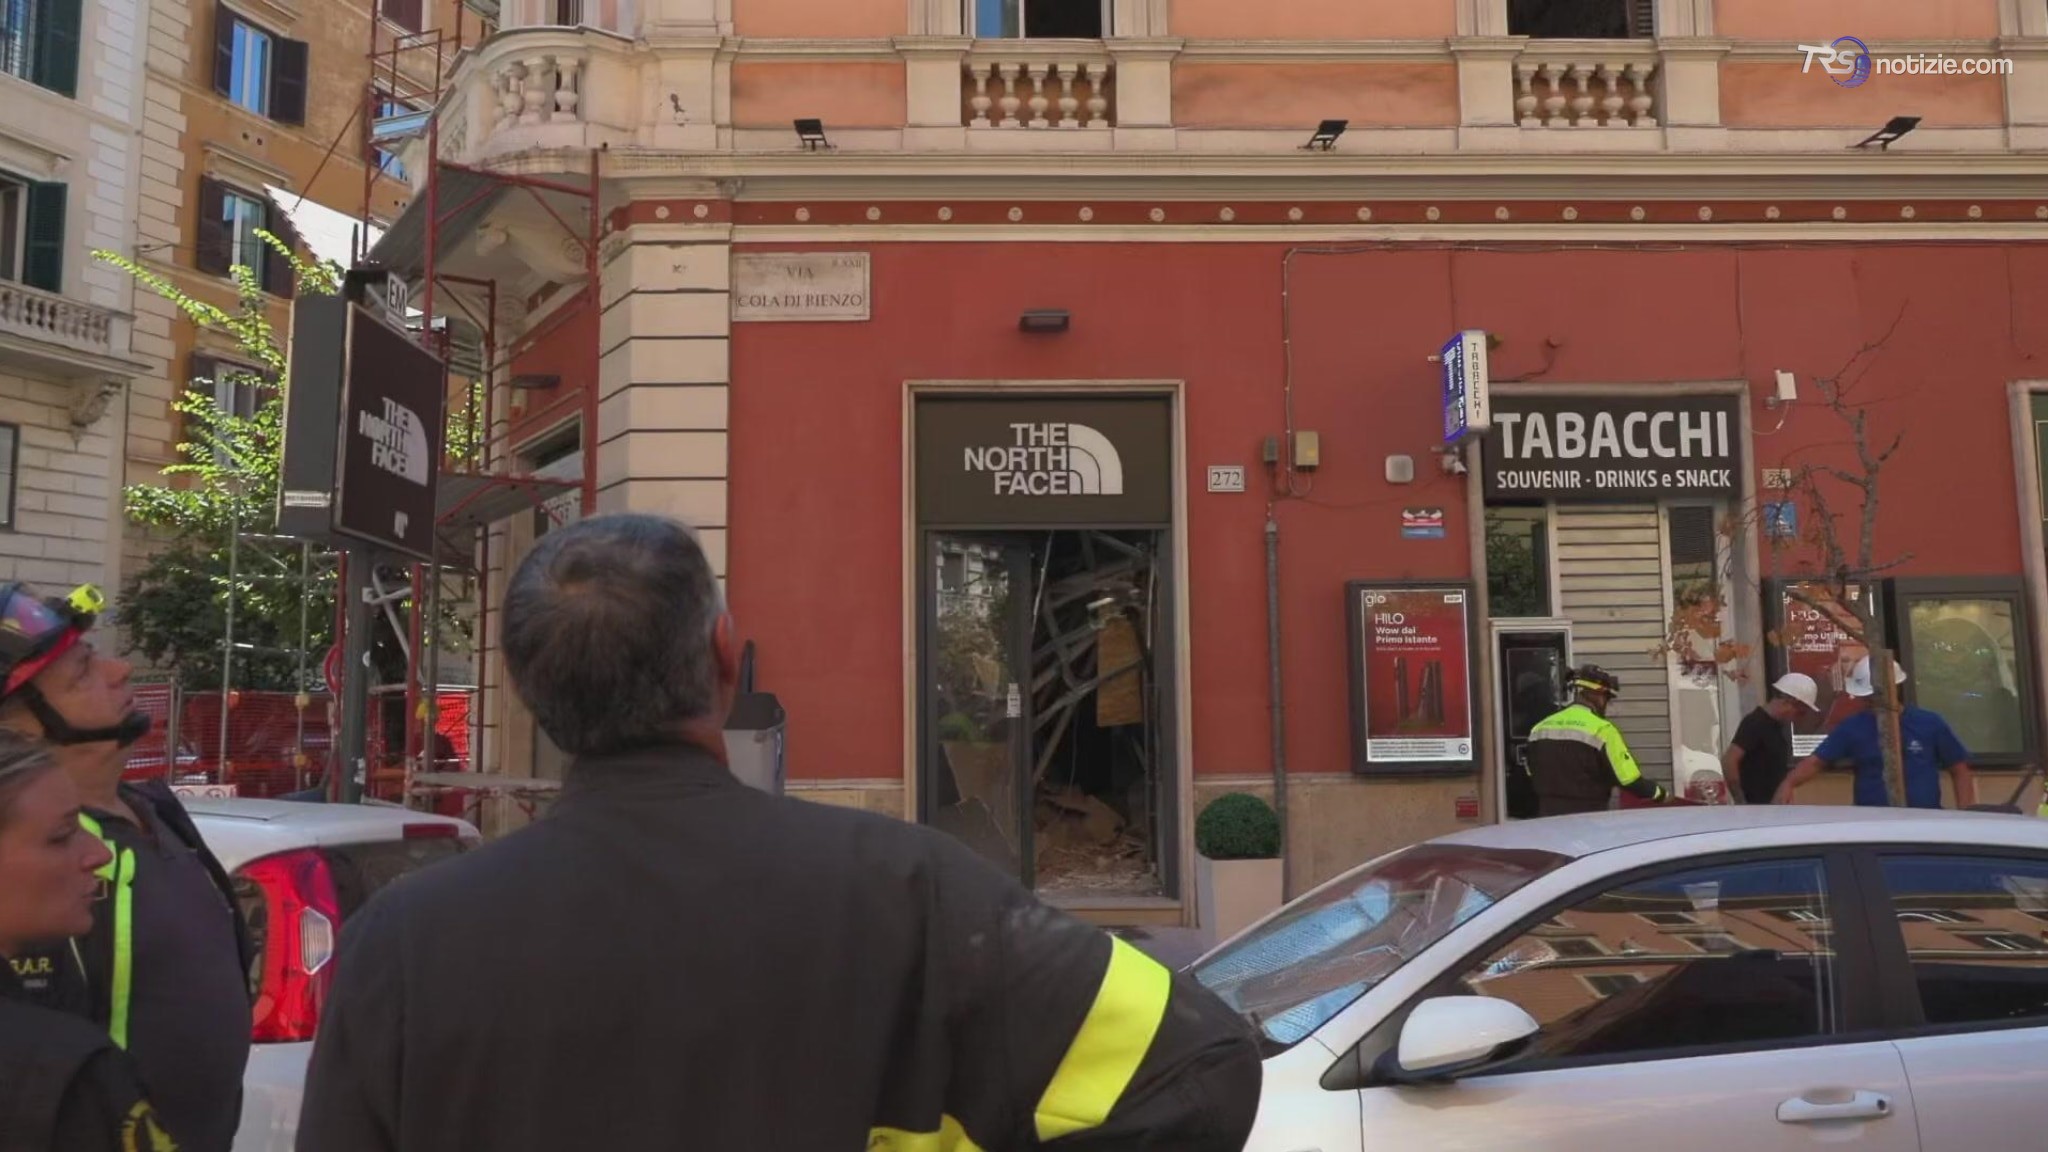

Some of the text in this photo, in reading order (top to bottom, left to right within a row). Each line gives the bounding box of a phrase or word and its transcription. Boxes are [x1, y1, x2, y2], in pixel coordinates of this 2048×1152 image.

[786, 266, 814, 280] VIA
[738, 293, 863, 308] COLA DI RIENZO
[1471, 342, 1482, 419] TABACCHI
[382, 396, 410, 429] THE
[1010, 423, 1066, 446] THE
[1493, 411, 1729, 459] TABACCHI
[372, 439, 407, 476] FACE
[964, 447, 1068, 471] NORTH
[994, 471, 1068, 495] FACE
[1212, 471, 1241, 487] 272
[1497, 470, 1581, 488] SOUVENIR
[1596, 469, 1657, 488] DRINKS
[1662, 473, 1671, 487] e
[1675, 469, 1731, 488] SNACK
[1365, 591, 1386, 607] glo
[1375, 612, 1404, 625] HILO
[1375, 626, 1416, 635] Wow dai
[1376, 635, 1438, 643] Primo Istante
